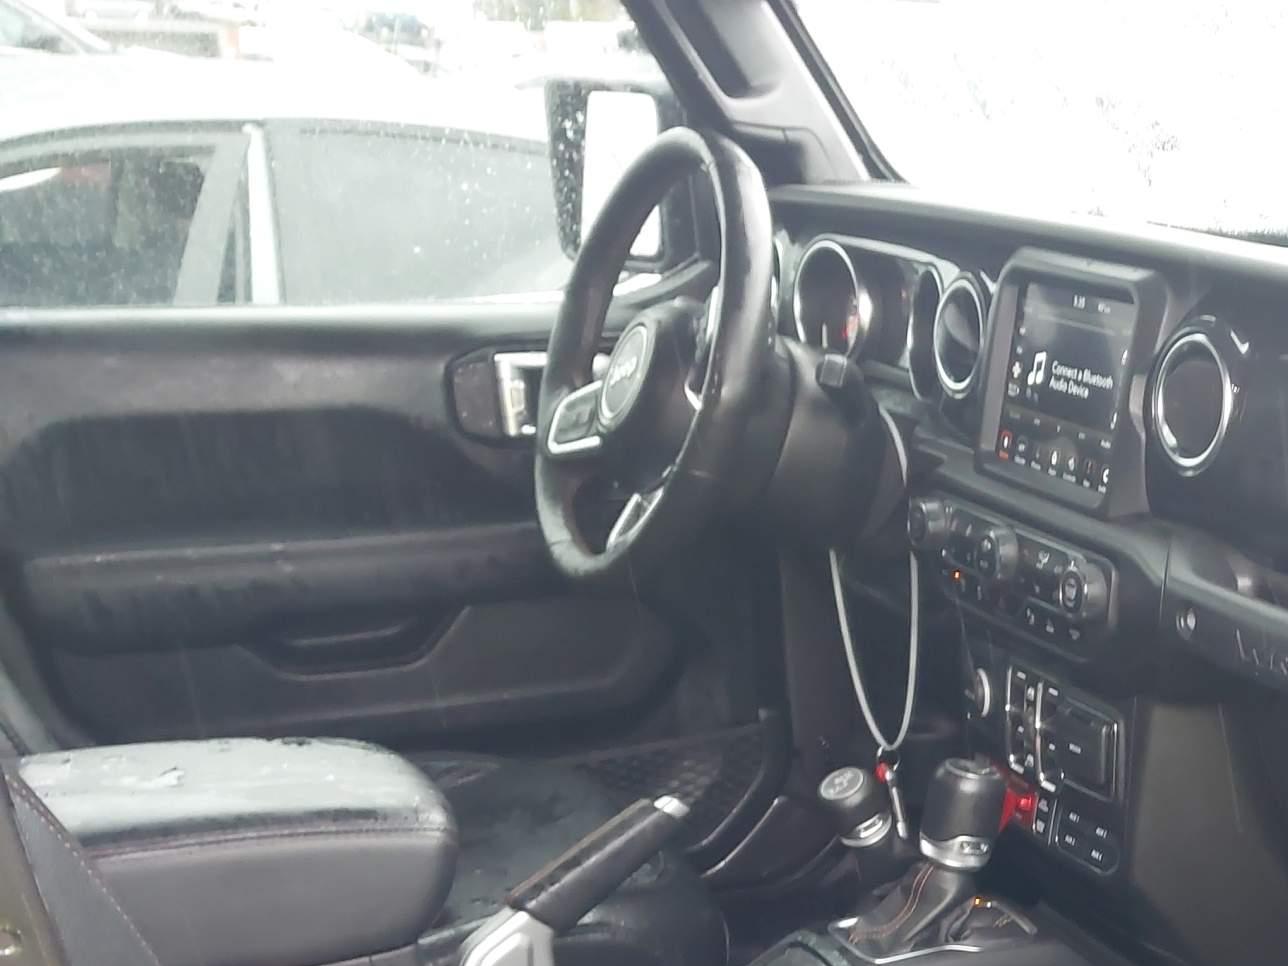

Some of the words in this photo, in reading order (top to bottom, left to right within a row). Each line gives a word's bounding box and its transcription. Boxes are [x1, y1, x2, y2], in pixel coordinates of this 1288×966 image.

[1049, 375, 1068, 393] Audio
[1068, 379, 1089, 399] Device
[1052, 361, 1078, 379] Connect
[1083, 368, 1113, 389] Bluetooth
